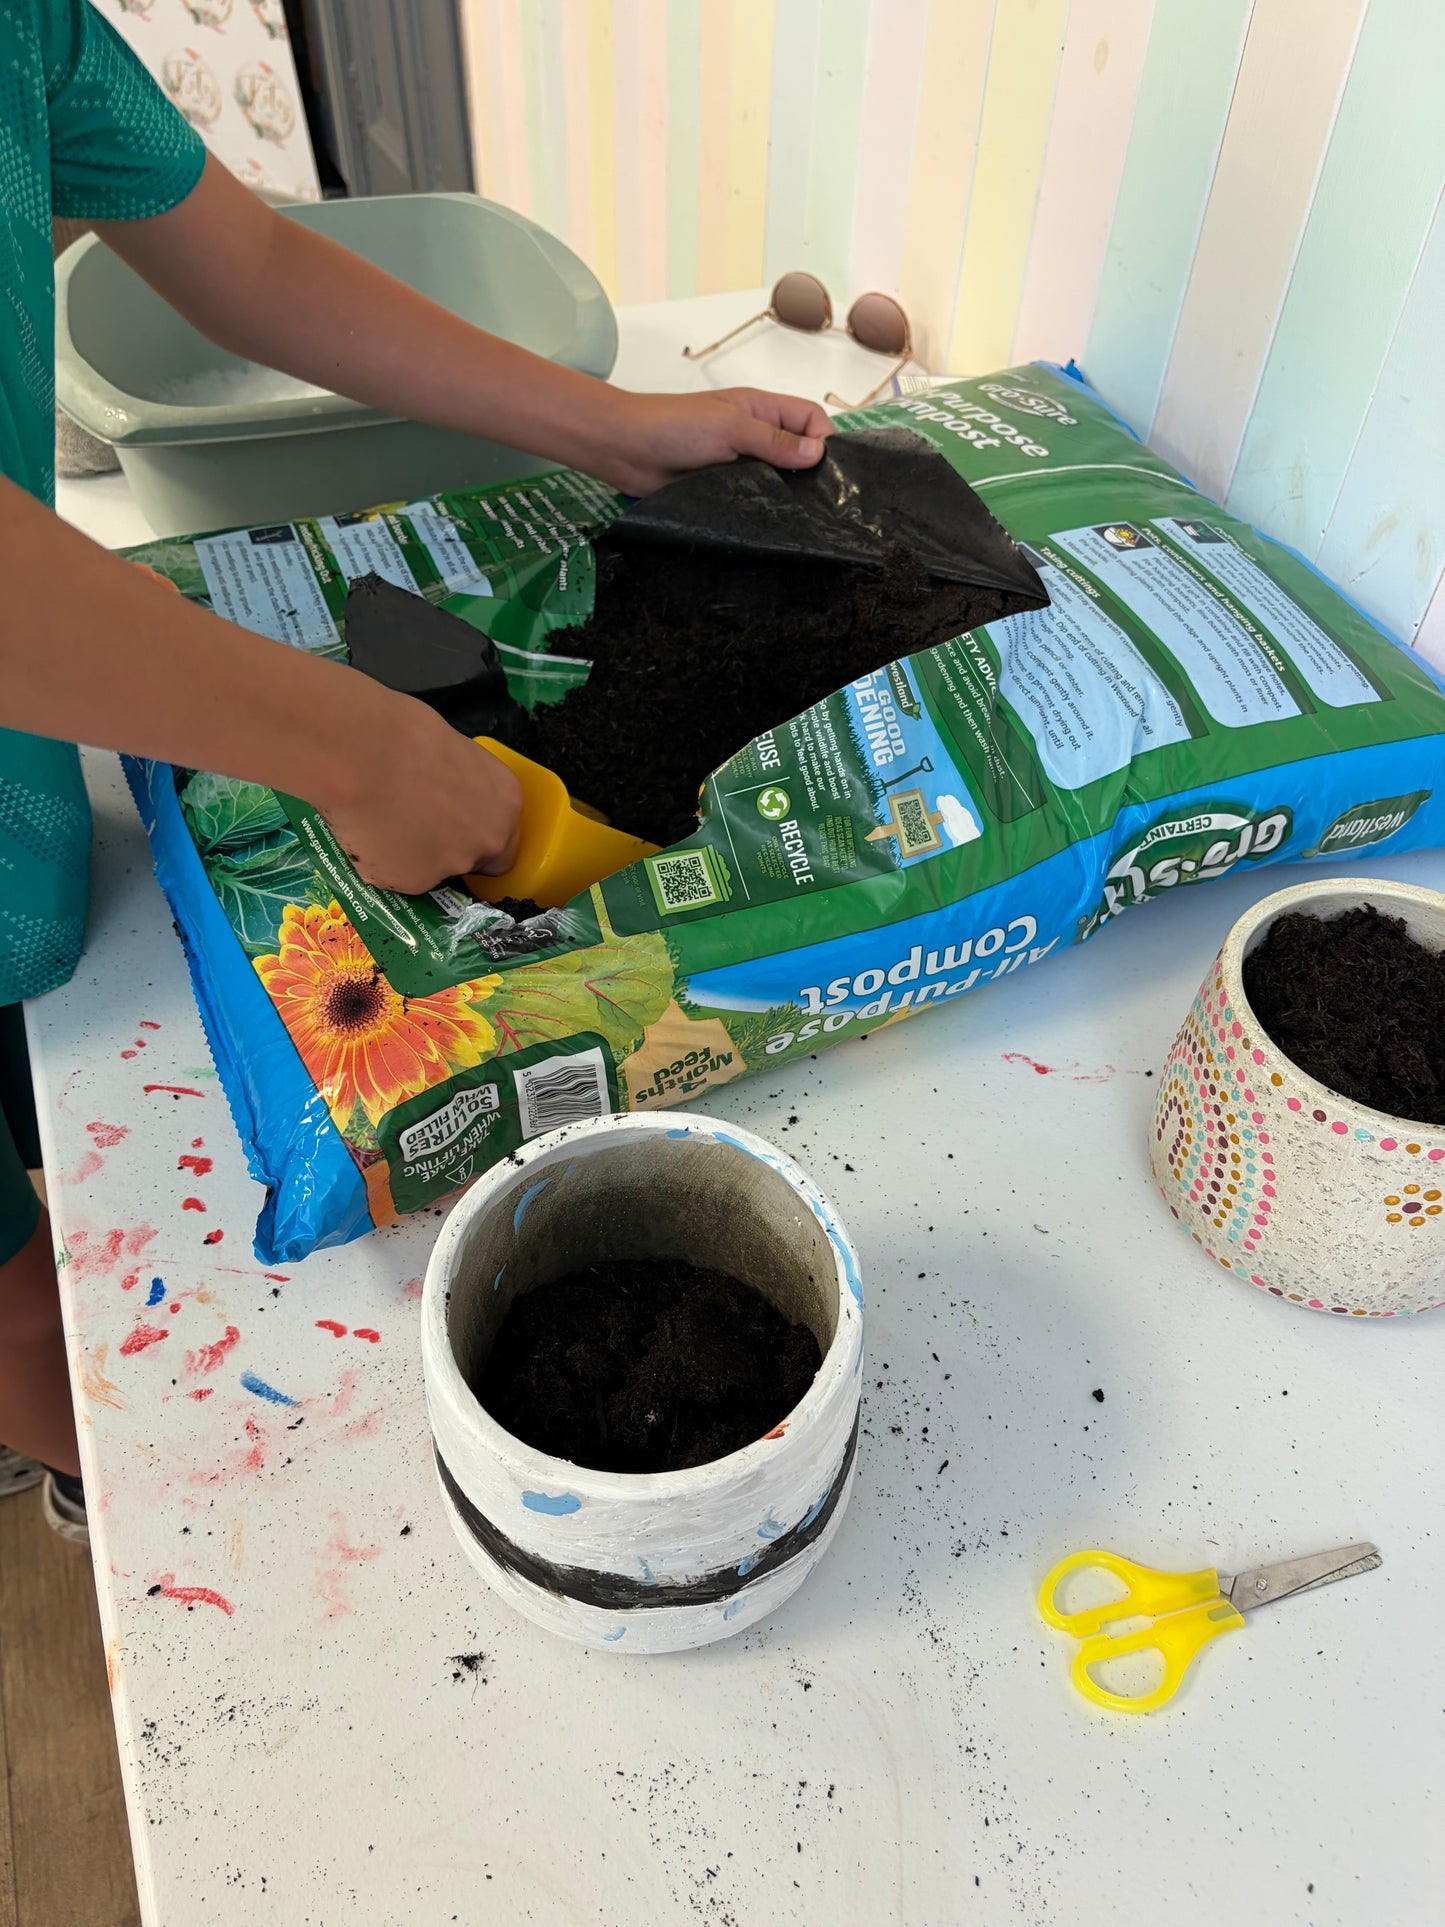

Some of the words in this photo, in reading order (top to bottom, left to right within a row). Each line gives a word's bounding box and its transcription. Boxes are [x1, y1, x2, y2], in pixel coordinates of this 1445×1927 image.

[558, 559, 568, 591] plants
[1040, 545, 1068, 570] Taking
[1066, 565, 1101, 599] cuttings
[1160, 544, 1207, 581] containers
[1203, 581, 1224, 597] and
[1219, 597, 1257, 633] hanging
[1254, 633, 1286, 672] baskets
[1029, 625, 1042, 644] with
[1038, 641, 1062, 663] pencil
[1057, 661, 1067, 669] or
[1051, 632, 1076, 662] rooting.
[1246, 642, 1273, 672] drainage
[952, 656, 967, 674] and
[961, 674, 980, 698] avoid
[1054, 619, 1069, 634] Dip
[1065, 630, 1080, 646] end
[1076, 643, 1087, 652] of
[1083, 649, 1108, 677] cutting
[1103, 674, 1114, 683] in
[1109, 682, 1139, 718] Westland
[1079, 630, 1096, 648] stem
[1093, 646, 1104, 657] of
[1099, 653, 1125, 680] cutting
[1119, 677, 1136, 692] and
[1141, 723, 1153, 736] all
[1181, 623, 1199, 638] edge
[1196, 639, 1211, 652] and
[1206, 652, 1229, 678] upright
[1224, 680, 1243, 702] plants
[1240, 704, 1249, 712] in
[1224, 641, 1240, 657] with
[1235, 658, 1252, 676] moss
[1248, 678, 1258, 686] or
[1254, 687, 1269, 705] liner
[928, 646, 958, 692] gardening
[952, 691, 967, 709] and
[963, 708, 979, 730] then
[974, 729, 991, 753] wash
[1025, 648, 1054, 678] compost
[1049, 675, 1071, 703] gently
[1066, 700, 1089, 730] around
[1084, 729, 1095, 741] it.
[1247, 658, 1263, 674] with
[1257, 675, 1283, 712] compost.
[819, 710, 831, 723] by
[873, 688, 908, 757] GOOD
[1010, 674, 1031, 696] direct
[1047, 728, 1063, 749] until
[1025, 671, 1035, 681] to
[1031, 678, 1057, 709] prevent
[1050, 706, 1072, 736] drying
[1067, 734, 1080, 750] out
[1165, 698, 1185, 728] gently
[787, 721, 800, 738] lots
[792, 738, 802, 748] to
[799, 721, 812, 742] hard
[813, 728, 830, 759] wildlife
[822, 722, 839, 752] getting
[753, 731, 780, 771] EUSE
[795, 747, 807, 765] feel
[805, 742, 814, 751] to
[799, 764, 814, 786] good
[807, 752, 822, 776] make
[822, 759, 835, 776] and
[831, 751, 846, 778] hands
[805, 785, 821, 812] about.
[815, 776, 826, 792] our
[827, 776, 841, 800] boost
[840, 778, 849, 789] on
[843, 789, 853, 799] in
[1324, 809, 1408, 843] westland
[315, 818, 333, 842] Westland
[345, 869, 364, 893] Limited
[360, 889, 376, 909] 2023
[755, 851, 767, 874] POINTS
[778, 818, 814, 887] RECYCLE
[296, 816, 371, 923] www.gardenhealth.com
[793, 910, 1043, 1020] Compost
[758, 935, 1063, 1057] All-Purpose
[632, 1049, 735, 1107] Months
[649, 1043, 714, 1087] Feed
[449, 1084, 491, 1111] WHEN
[678, 1077, 706, 1095] 4
[466, 1094, 494, 1116] 50
[403, 1110, 450, 1145] FILLED
[406, 1112, 468, 1158] LITRES
[458, 1126, 490, 1156] TAKE
[460, 1109, 502, 1146] WHEN
[401, 1143, 461, 1178] LIFTING
[419, 1155, 457, 1183] CARE
